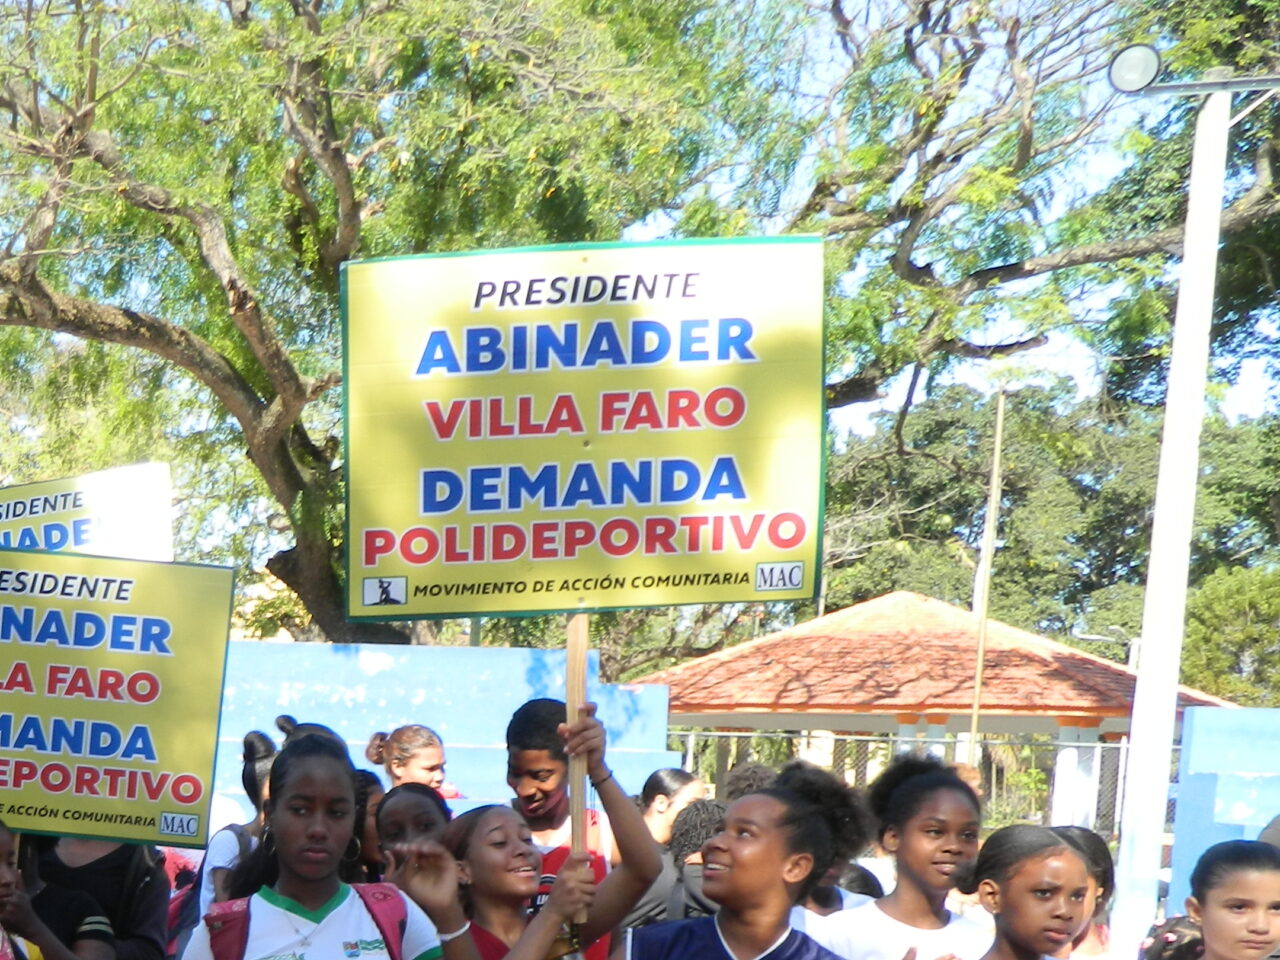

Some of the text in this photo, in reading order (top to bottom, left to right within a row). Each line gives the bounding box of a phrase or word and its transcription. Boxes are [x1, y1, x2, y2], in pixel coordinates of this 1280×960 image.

[474, 272, 701, 309] PRESIDENTE
[415, 317, 755, 375] ABINADER
[426, 387, 746, 440] VILLA FARO
[421, 457, 747, 514] DEMANDA
[363, 512, 807, 567] POLIDEPORTIVO
[413, 571, 751, 598] MOVIMIENTO DE ACCIÓN COMUNITARIA
[757, 564, 803, 590] MAC
[47, 664, 160, 703] FARO
[6, 802, 59, 820] ACCIÓN
[62, 809, 157, 828] COMUNITARIA
[161, 814, 199, 837] MAC
